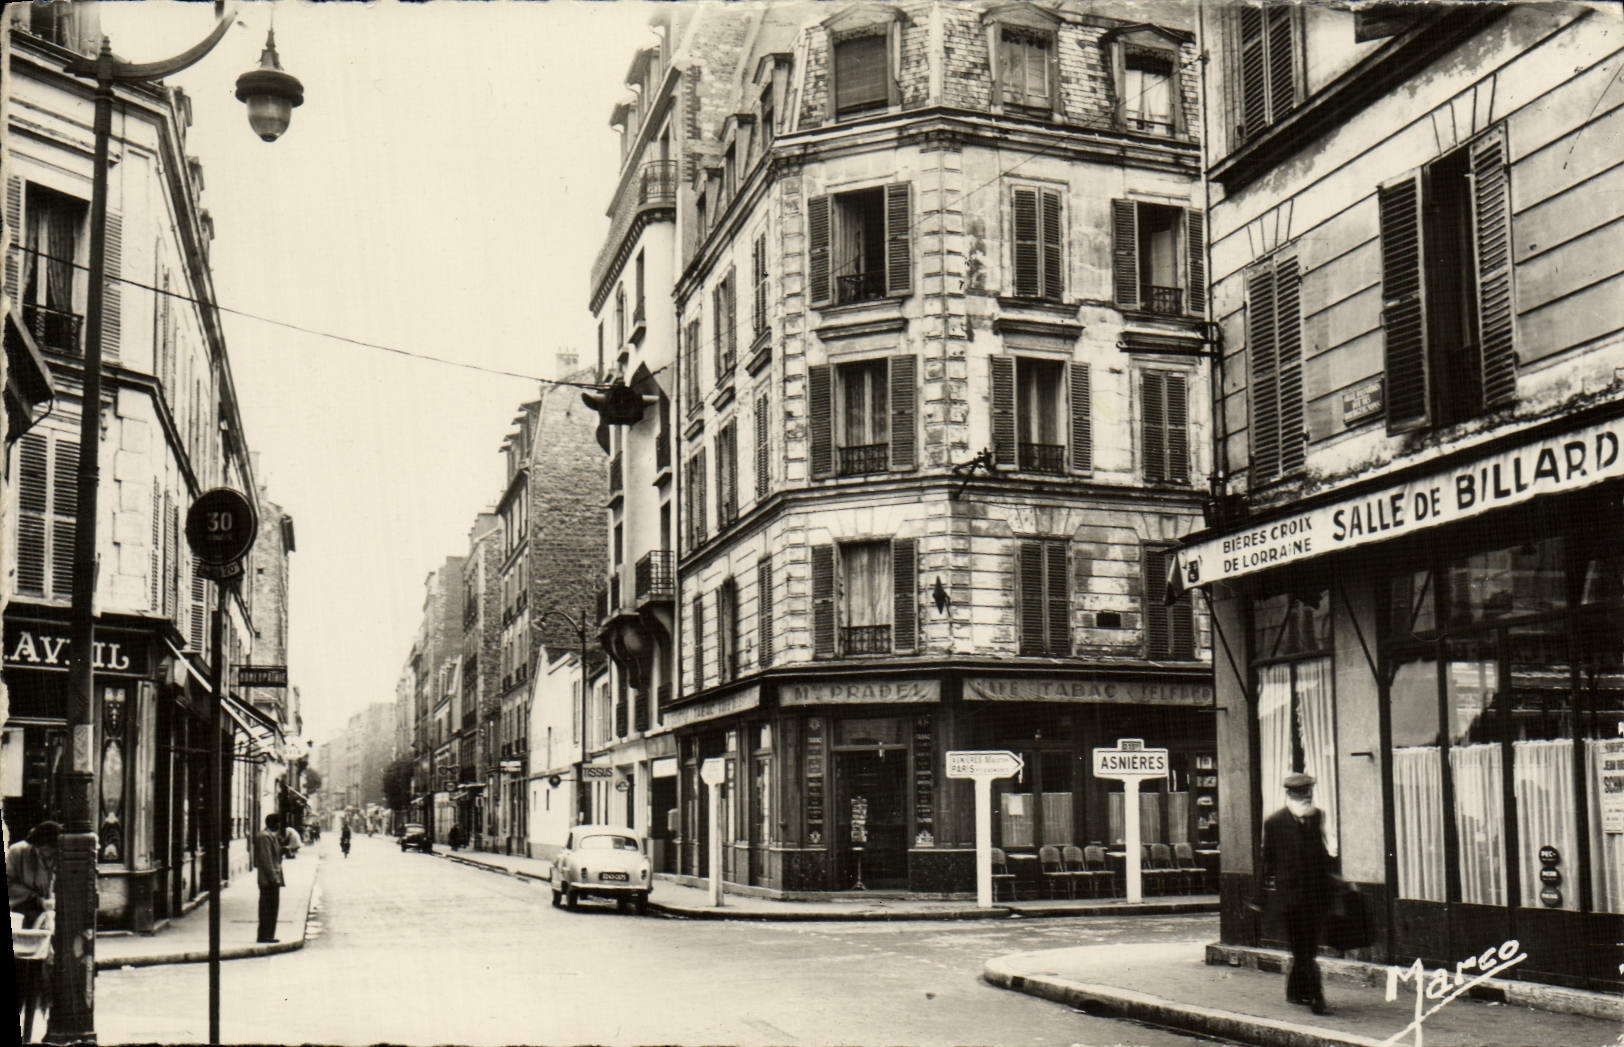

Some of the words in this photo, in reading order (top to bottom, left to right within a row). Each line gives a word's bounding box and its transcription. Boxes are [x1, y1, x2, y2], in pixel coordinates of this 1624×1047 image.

[1332, 492, 1405, 542] SALLE
[1415, 486, 1441, 521] DE
[1455, 430, 1619, 510] BILLARD
[207, 511, 233, 532] 30
[1270, 516, 1313, 540] CROIX
[1223, 557, 1239, 573] DE
[1242, 537, 1312, 568] LORRAINE
[1040, 682, 1117, 698] TABAC
[583, 767, 613, 777] TISSUS
[1101, 754, 1165, 770] ASNIÈRES
